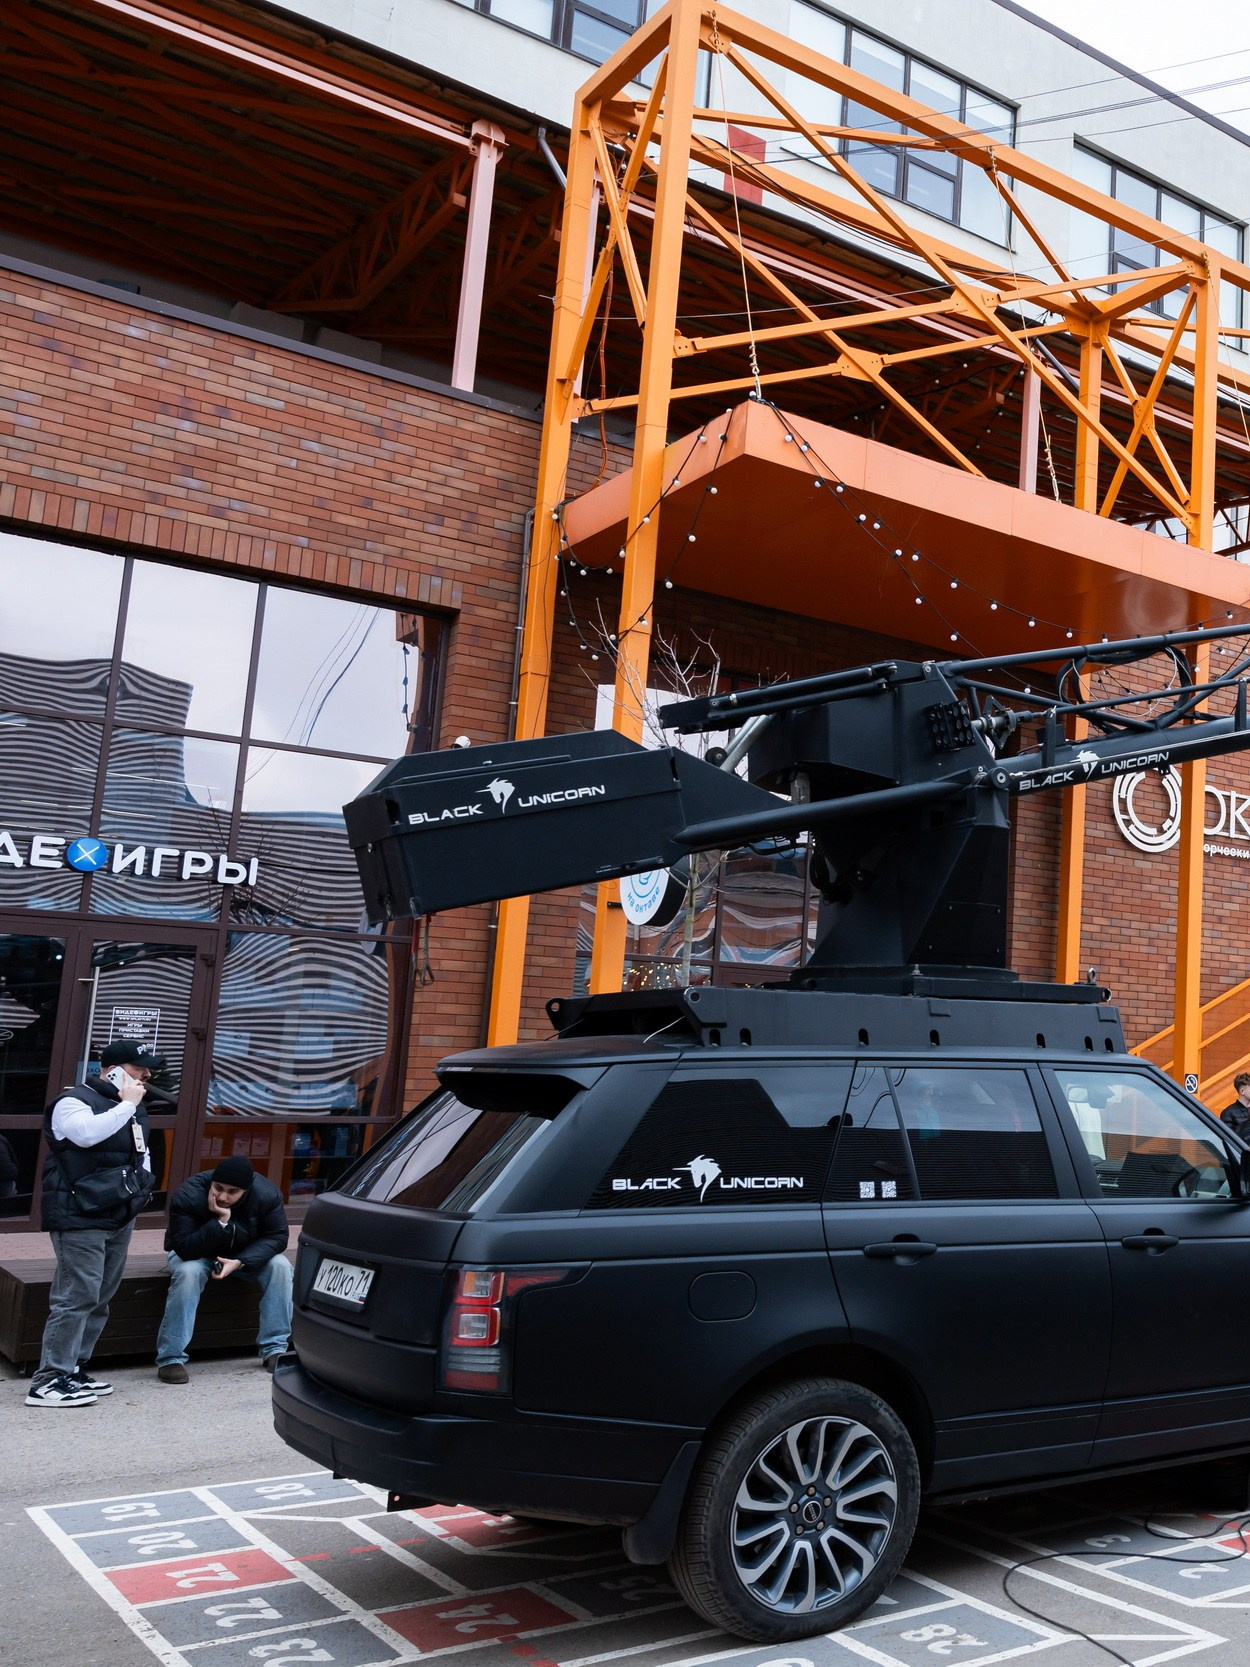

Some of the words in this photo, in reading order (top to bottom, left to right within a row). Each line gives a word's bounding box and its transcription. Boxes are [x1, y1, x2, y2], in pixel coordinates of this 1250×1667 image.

[1019, 770, 1074, 791] BLACK
[1101, 752, 1170, 774] UNICORN
[408, 803, 484, 825] BLACK
[518, 784, 606, 808] UNICORN
[612, 1177, 682, 1191] BLACK
[720, 1176, 804, 1188] UNICORN
[254, 1482, 316, 1501] 18
[101, 1502, 162, 1522] 19
[127, 1531, 199, 1555] 20
[1084, 1533, 1132, 1548] 3
[165, 1562, 240, 1589] 21
[1178, 1561, 1230, 1579] 2
[204, 1596, 284, 1628] 22
[435, 1602, 520, 1634] 24
[249, 1637, 336, 1667] 23
[900, 1622, 989, 1655] 28
